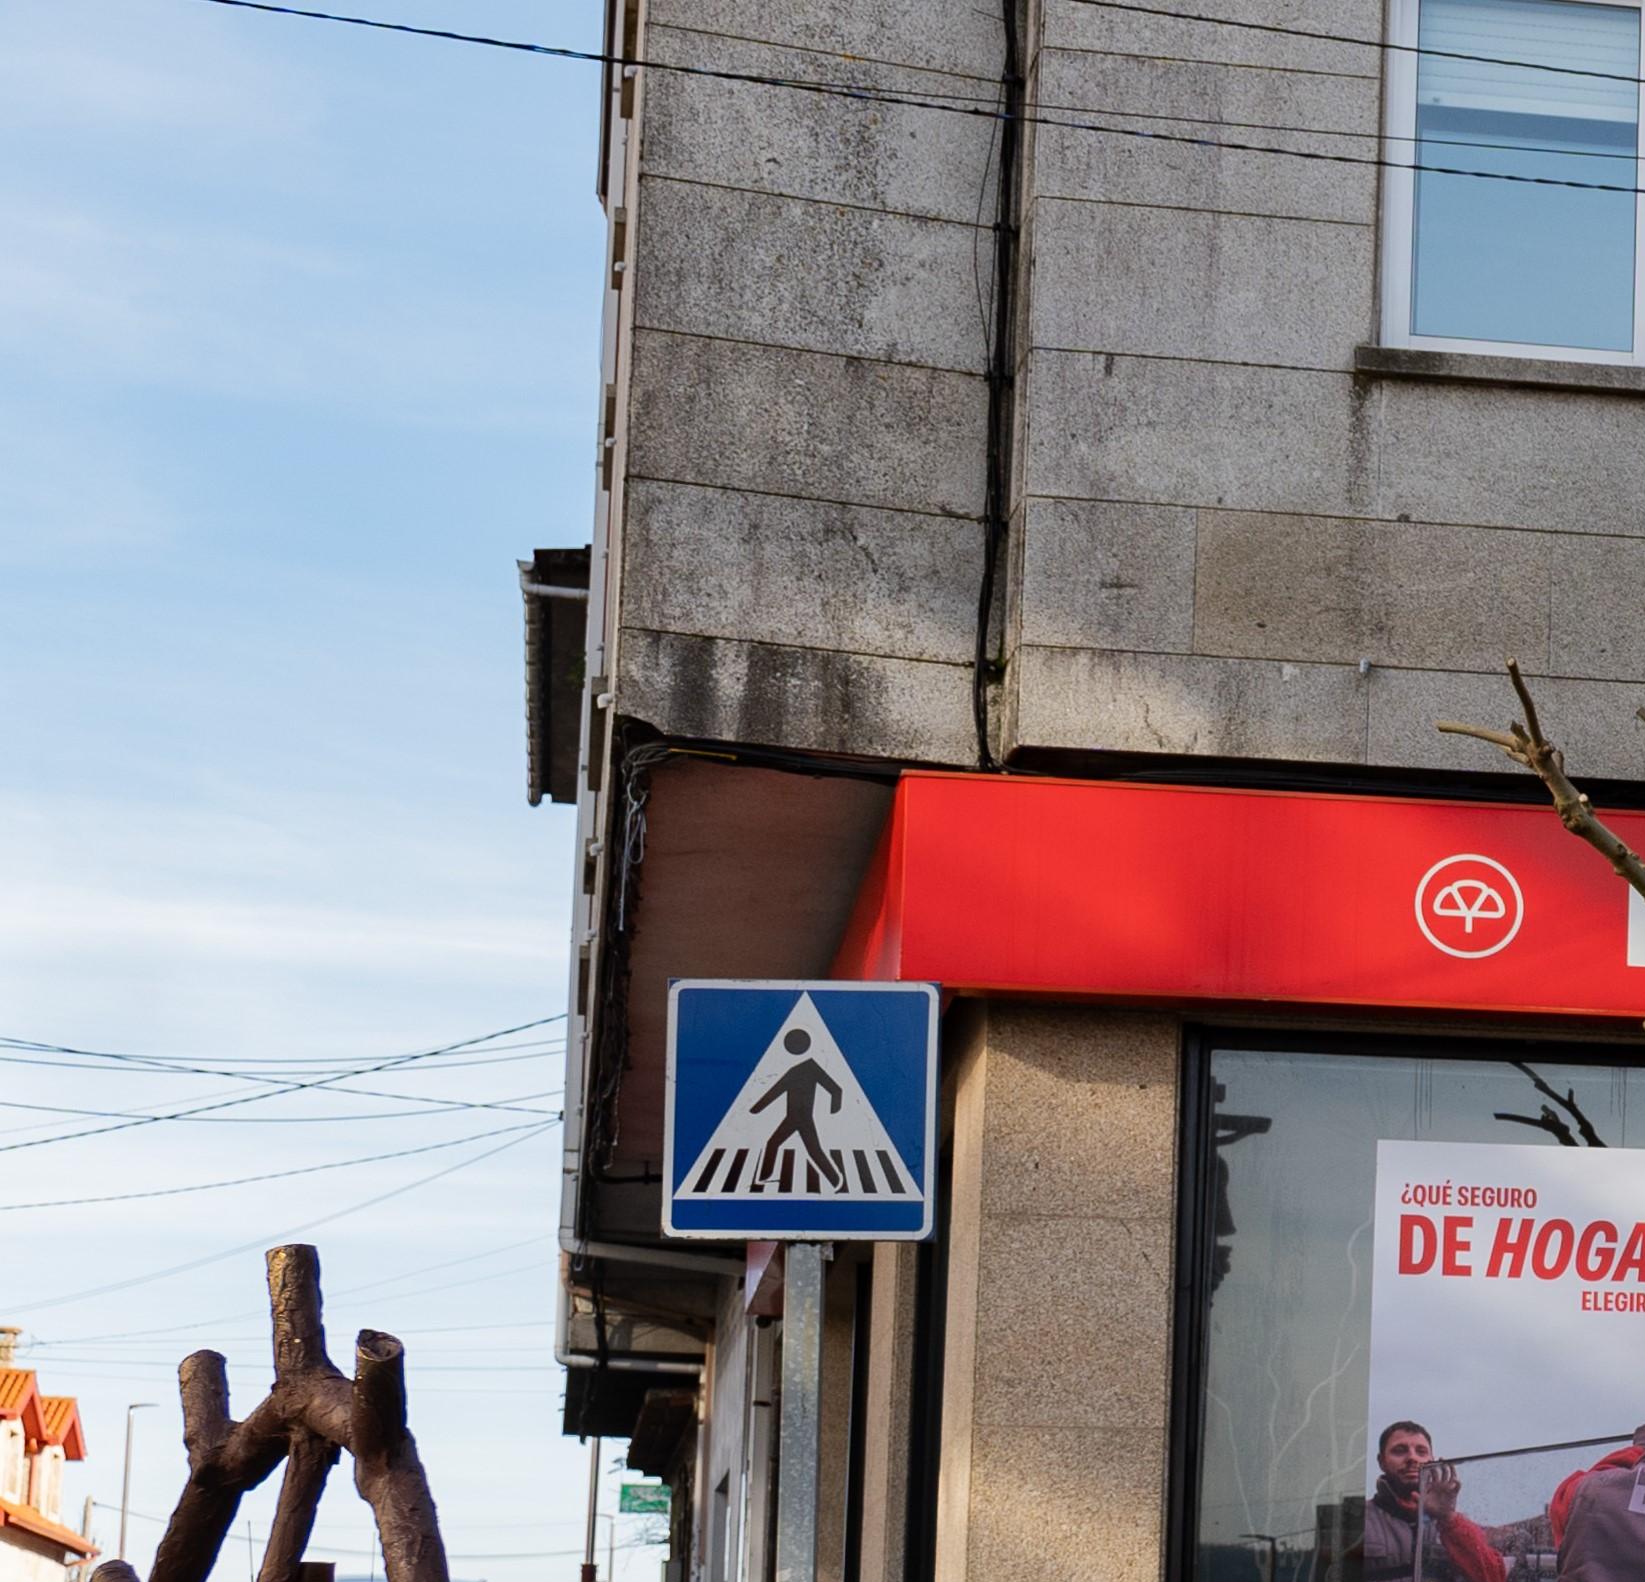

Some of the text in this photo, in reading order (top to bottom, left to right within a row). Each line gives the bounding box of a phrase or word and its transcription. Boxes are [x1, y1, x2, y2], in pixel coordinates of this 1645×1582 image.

[1401, 1180, 1538, 1209] ¿QUÉ SEGURO
[1398, 1213, 1474, 1278] DE
